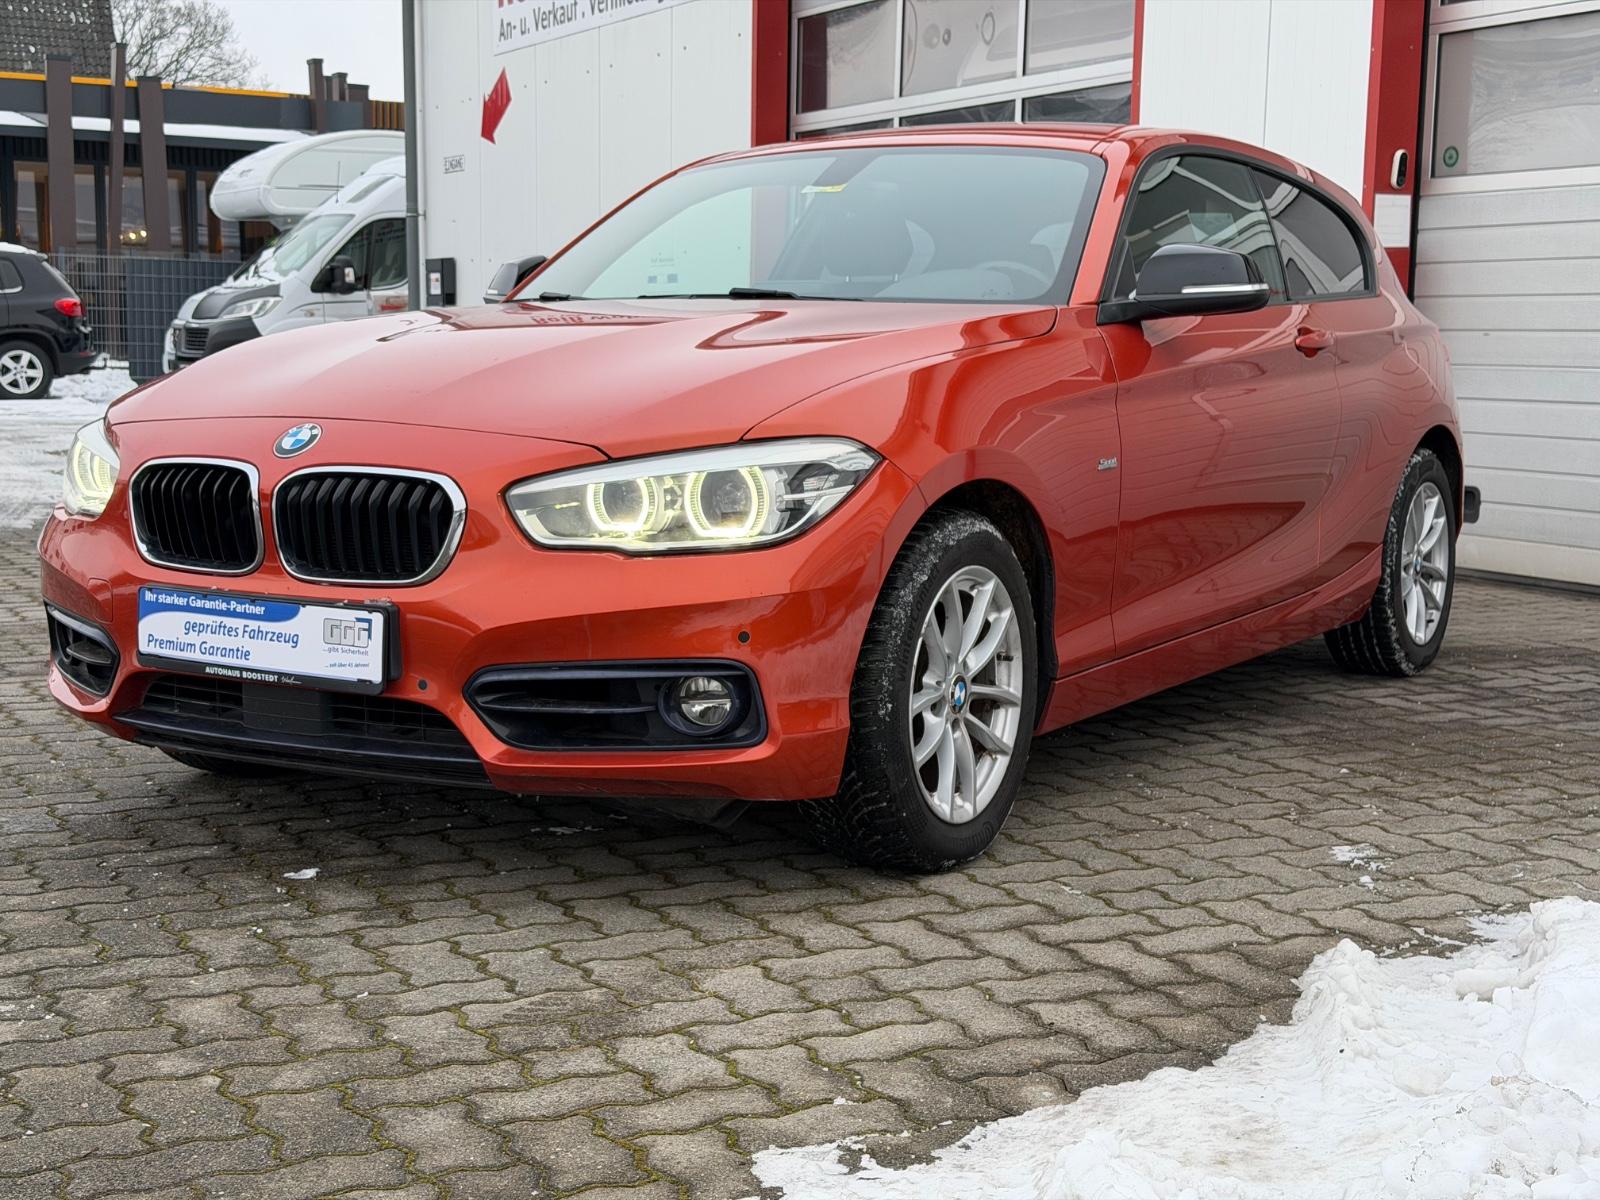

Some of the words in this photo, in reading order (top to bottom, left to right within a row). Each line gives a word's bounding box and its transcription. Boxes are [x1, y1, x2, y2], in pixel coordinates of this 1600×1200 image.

[498, 18, 517, 41] An-
[519, 16, 531, 36] u.
[532, 1, 579, 32] Verkauf
[144, 590, 158, 602] Ihr
[157, 593, 188, 607] starker
[188, 596, 266, 615] Garantie-Partner
[147, 633, 196, 654] Premium
[199, 641, 251, 661] Garantie
[184, 620, 240, 638] geprüftes
[241, 624, 300, 648] Fahrzeug
[205, 666, 241, 677] AUTOHAUS
[242, 671, 279, 682] BOOSTEDT
